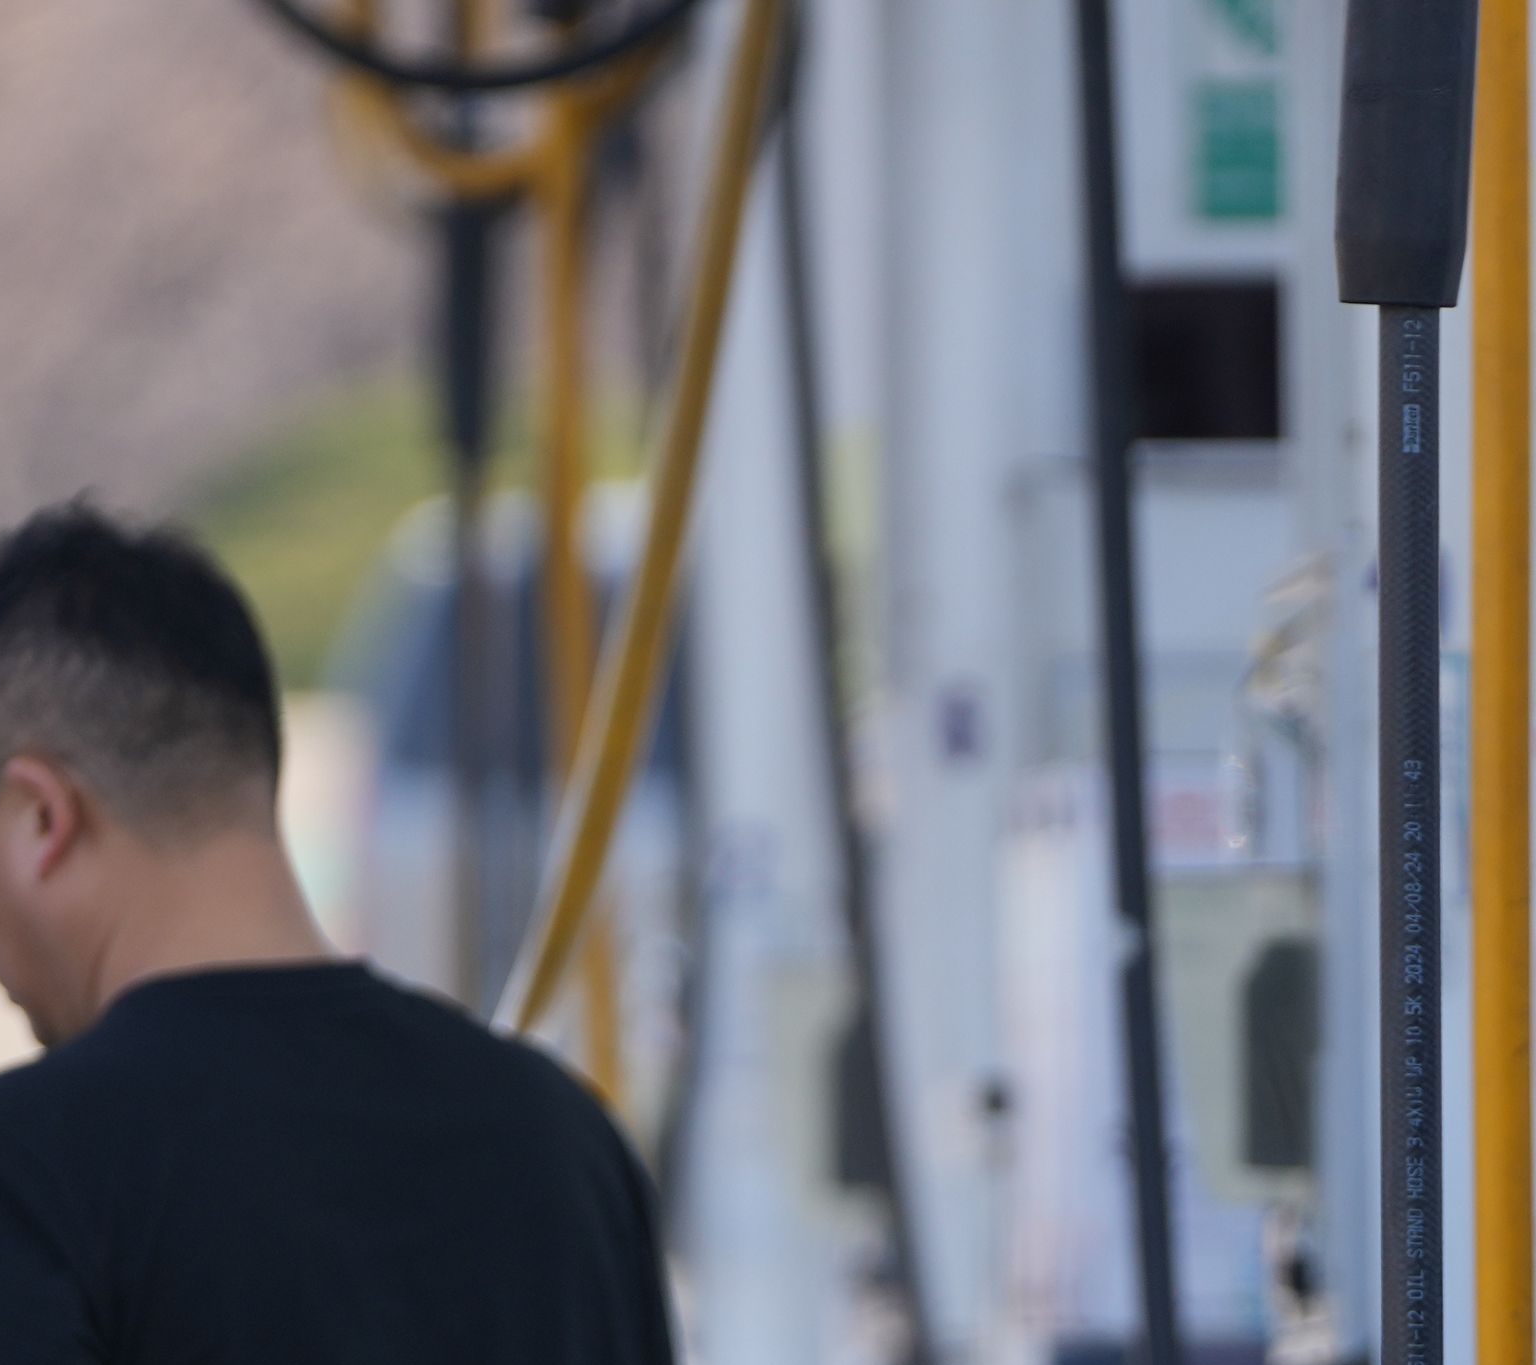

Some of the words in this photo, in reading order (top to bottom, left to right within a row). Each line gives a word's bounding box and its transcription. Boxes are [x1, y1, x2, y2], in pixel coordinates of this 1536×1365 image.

[1403, 319, 1422, 393] F511-12
[1404, 851, 1423, 934] 04/08/24
[1404, 944, 1423, 985] 2024
[1406, 1155, 1424, 1200] HOSE
[1406, 1208, 1425, 1259] STAND
[1407, 1269, 1425, 1301] OIL
